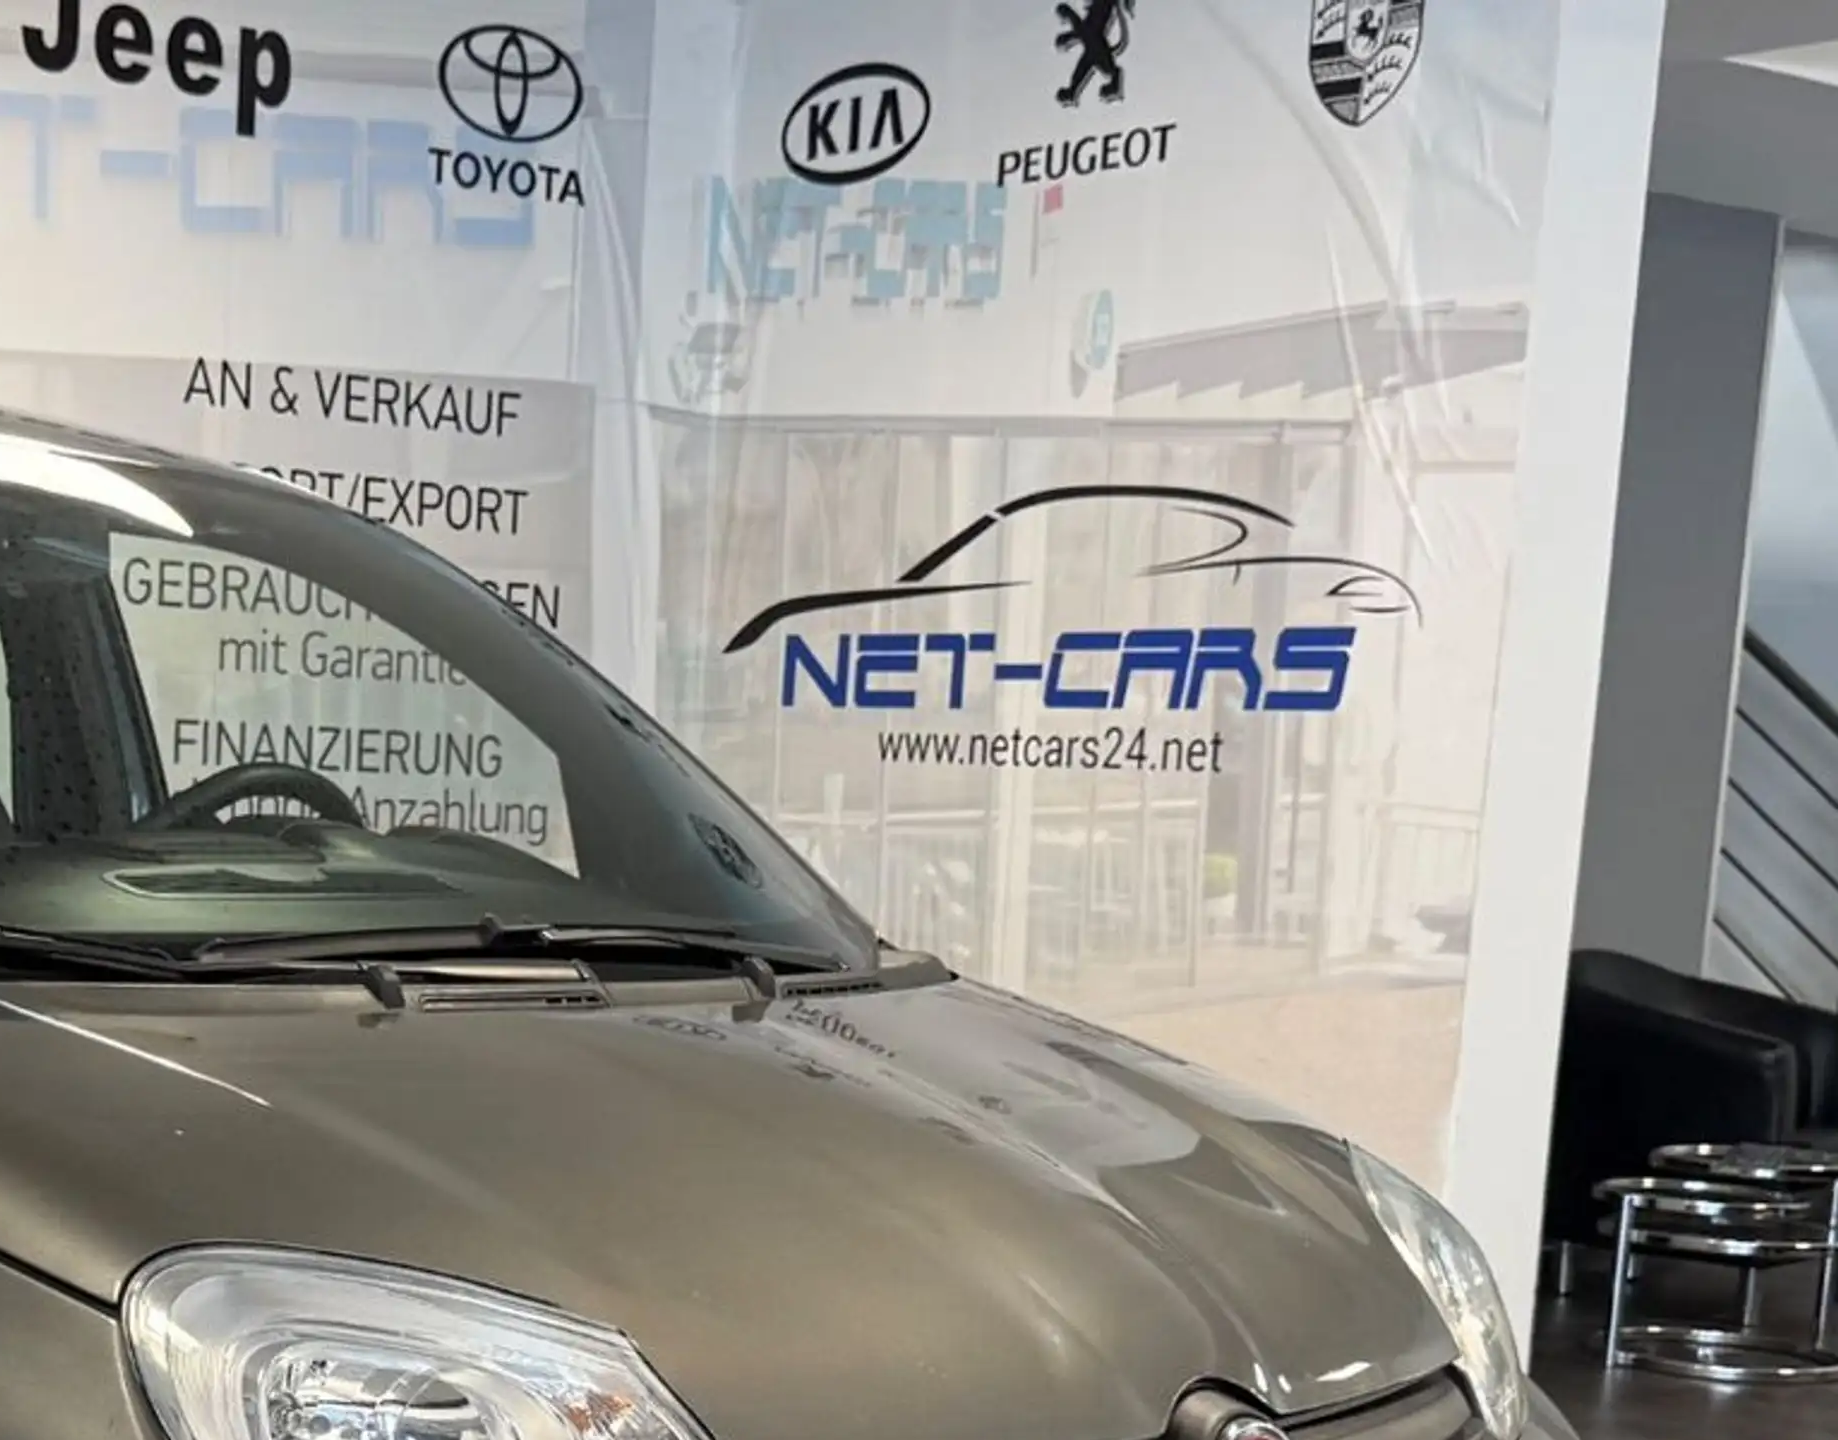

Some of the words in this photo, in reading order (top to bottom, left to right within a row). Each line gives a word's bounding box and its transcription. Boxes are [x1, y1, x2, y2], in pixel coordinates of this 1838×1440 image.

[22, 0, 293, 137] Jeep
[805, 91, 905, 162] KIA
[996, 124, 1177, 188] PEUGEOT
[428, 147, 586, 207] TOYOTA
[183, 356, 252, 410] AN
[269, 365, 299, 416] &
[314, 369, 523, 438] VERKAUF
[218, 630, 288, 676] mit
[781, 626, 1357, 712] NET-CARS
[172, 717, 504, 778] FINANZIERUNG
[877, 727, 1225, 774] www.netcars24.net
